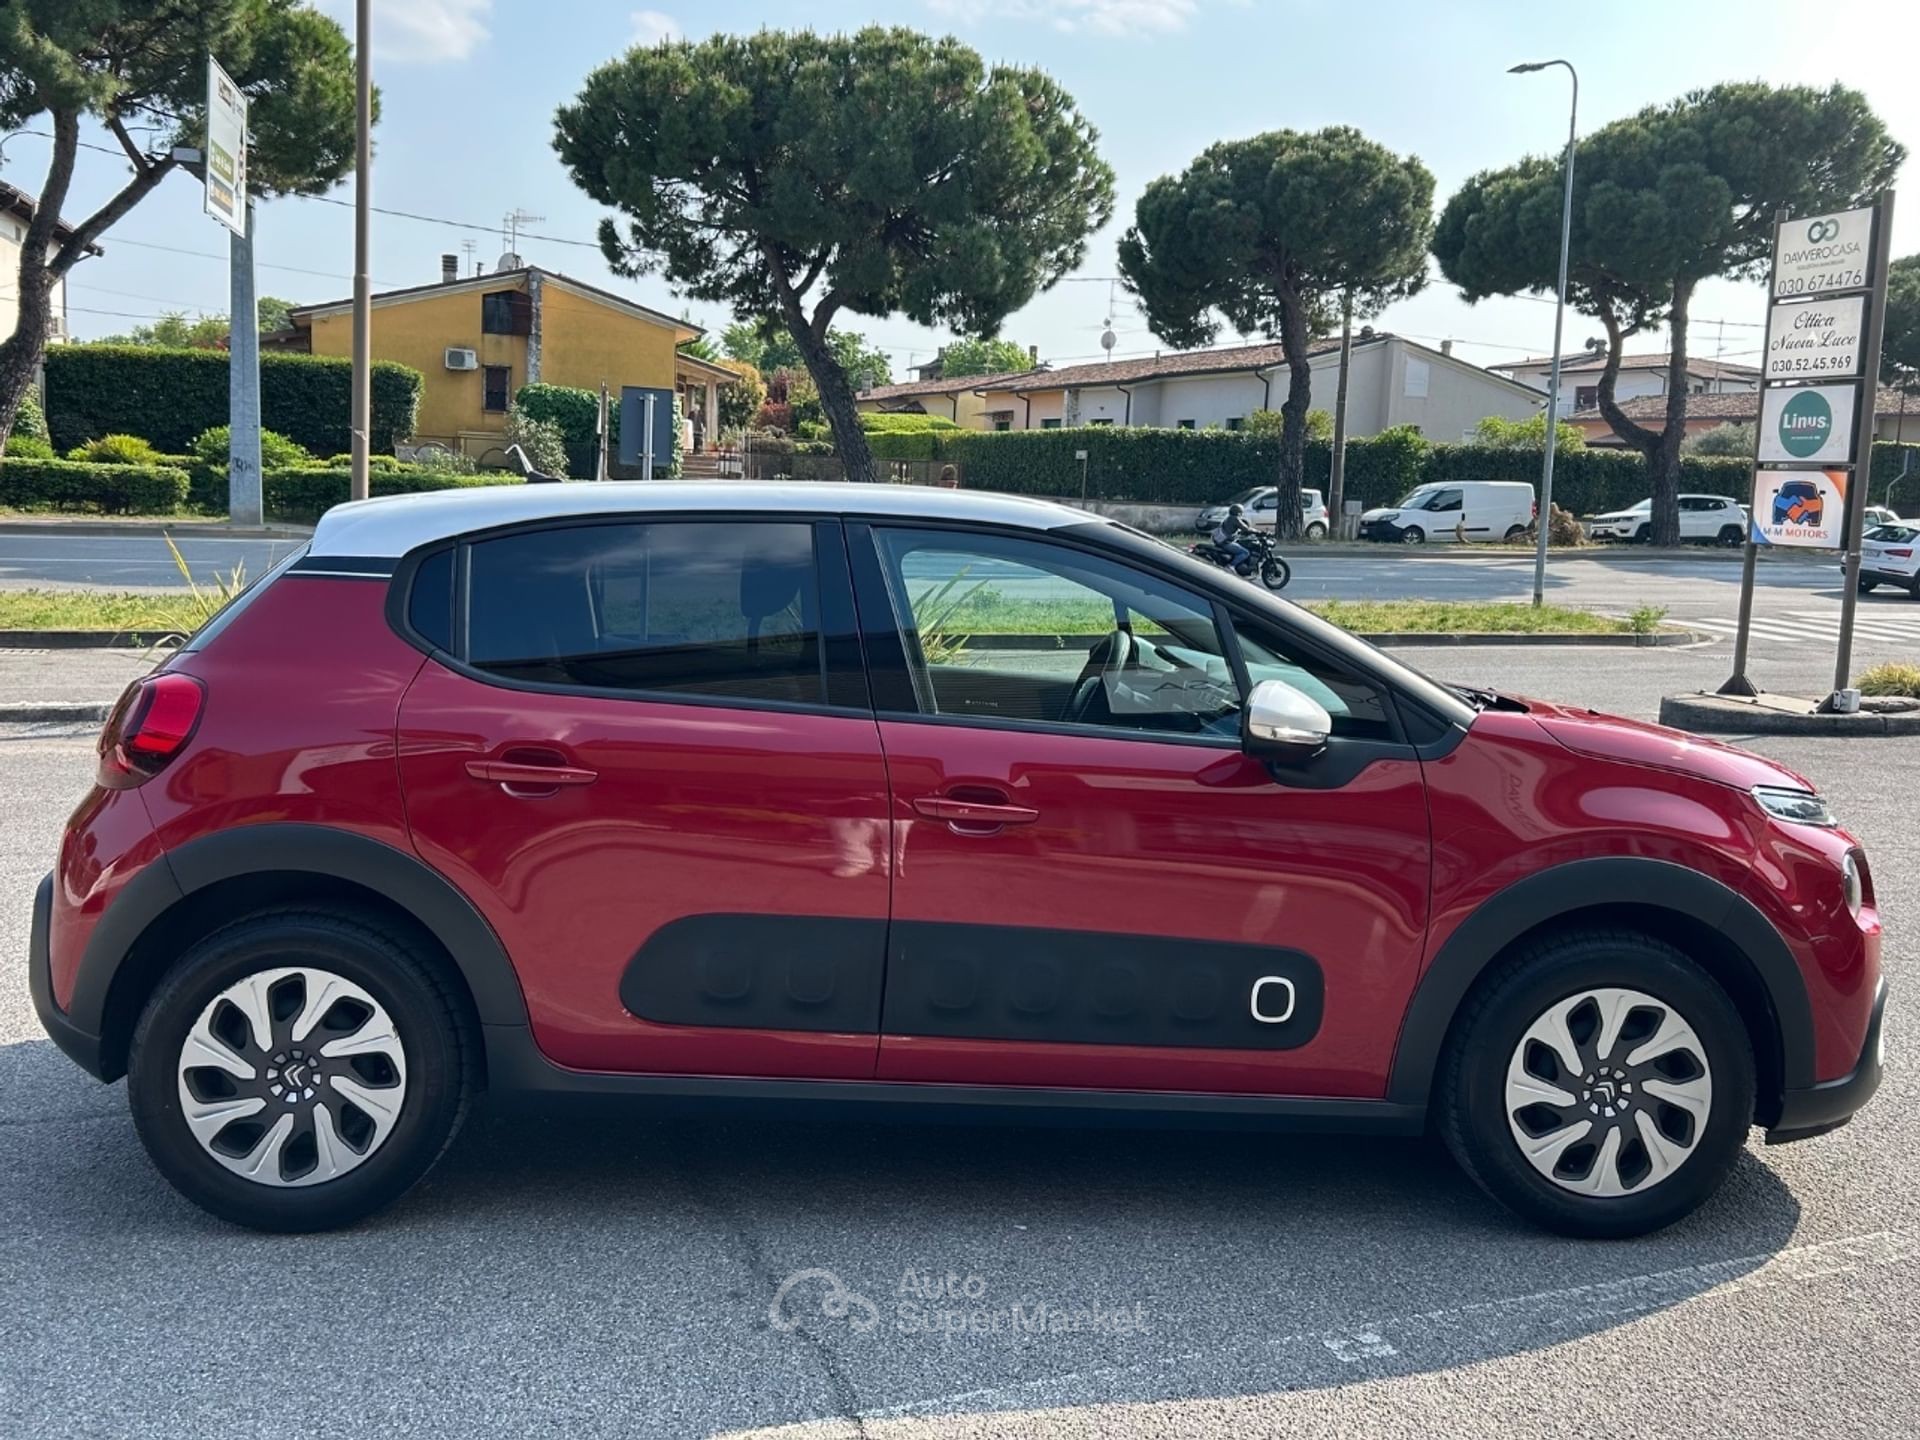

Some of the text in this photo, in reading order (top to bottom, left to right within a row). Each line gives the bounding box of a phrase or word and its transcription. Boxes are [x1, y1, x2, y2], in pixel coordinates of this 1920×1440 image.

[1783, 242, 1860, 265] DAVVEROCASA
[1778, 269, 1862, 295] 030 674476
[1794, 311, 1835, 329] Ottica
[1771, 330, 1857, 351] Nuova Luce
[1772, 355, 1852, 372] 030.52.45.969
[1783, 413, 1827, 429] Linus
[1785, 528, 1829, 539] MOTORS
